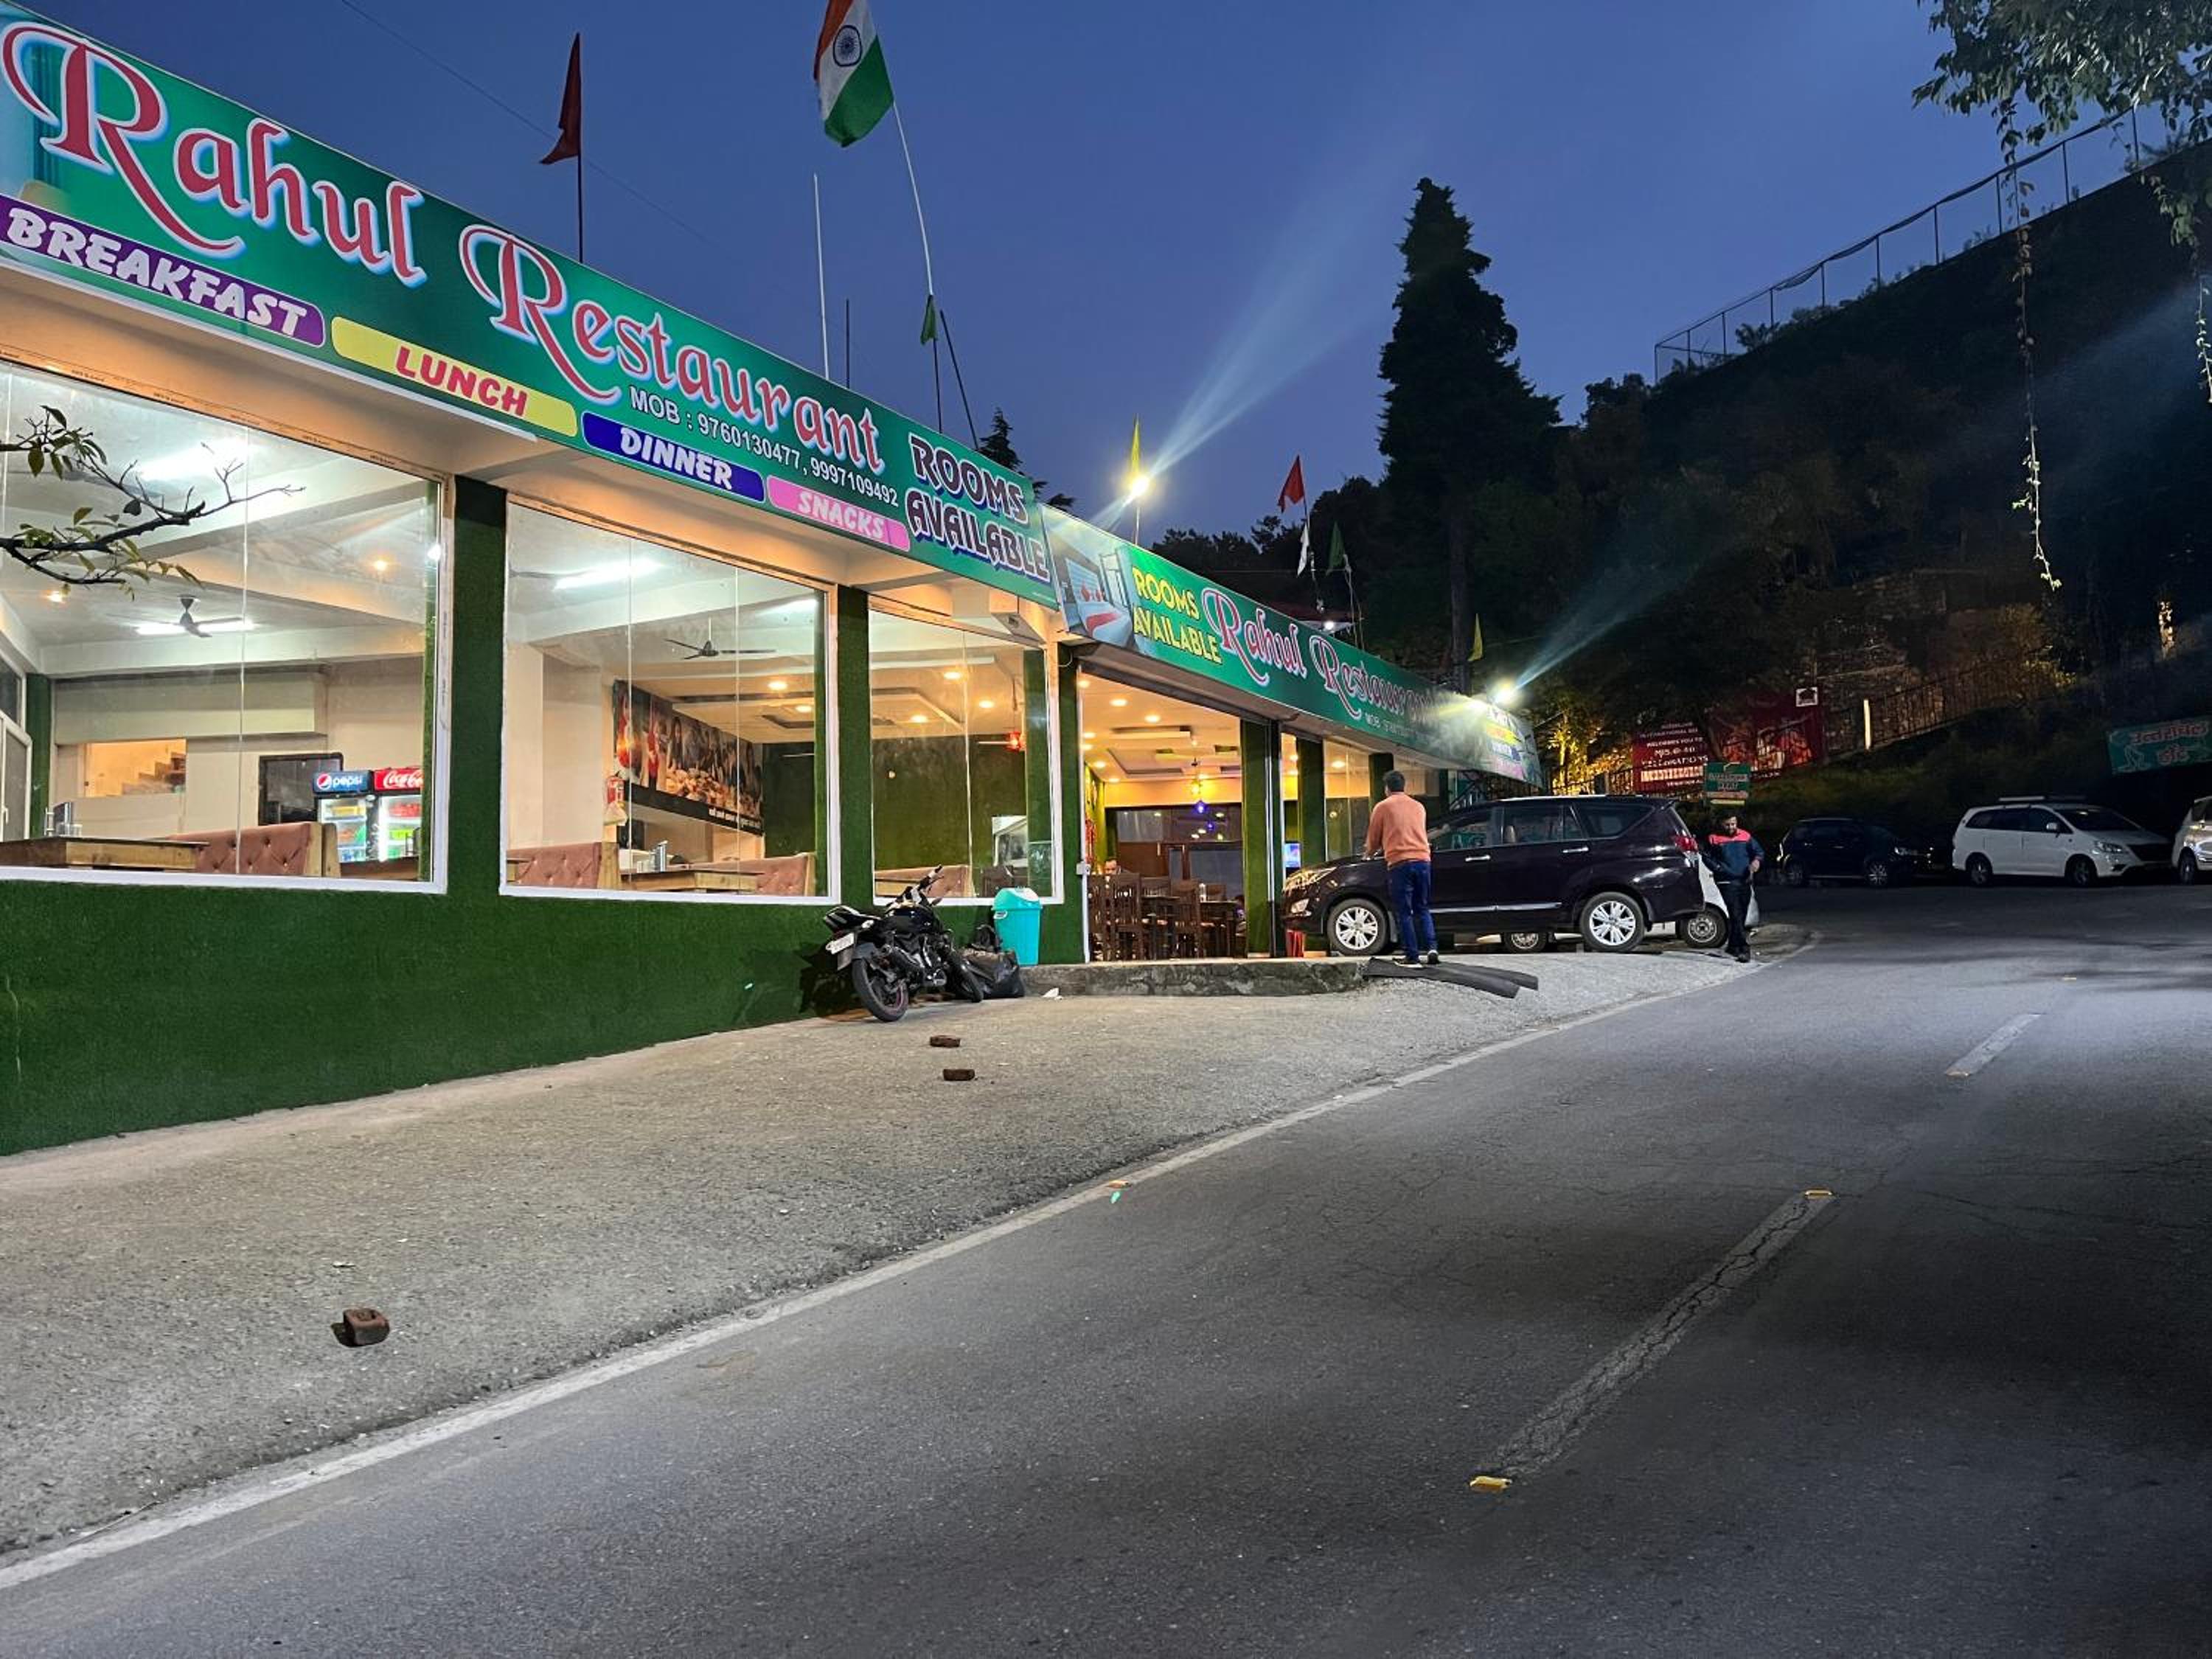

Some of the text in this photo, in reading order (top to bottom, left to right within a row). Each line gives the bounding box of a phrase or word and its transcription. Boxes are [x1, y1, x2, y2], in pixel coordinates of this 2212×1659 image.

[2, 21, 886, 476] Rahul Restaurant
[7, 207, 307, 339] BREAKFAST
[395, 346, 528, 417] LUNCH
[620, 427, 733, 490] DINNER
[629, 386, 681, 425] MOB
[810, 456, 900, 508] 9997109492
[908, 431, 1029, 525] ROOMS
[799, 492, 885, 540] SNACKS
[904, 487, 1051, 585] AVAILABLE
[1133, 566, 1200, 620] ROOMS
[1133, 613, 1222, 664] AVAILABLE
[1201, 586, 1307, 689] Rahul
[332, 775, 363, 788] pepsi
